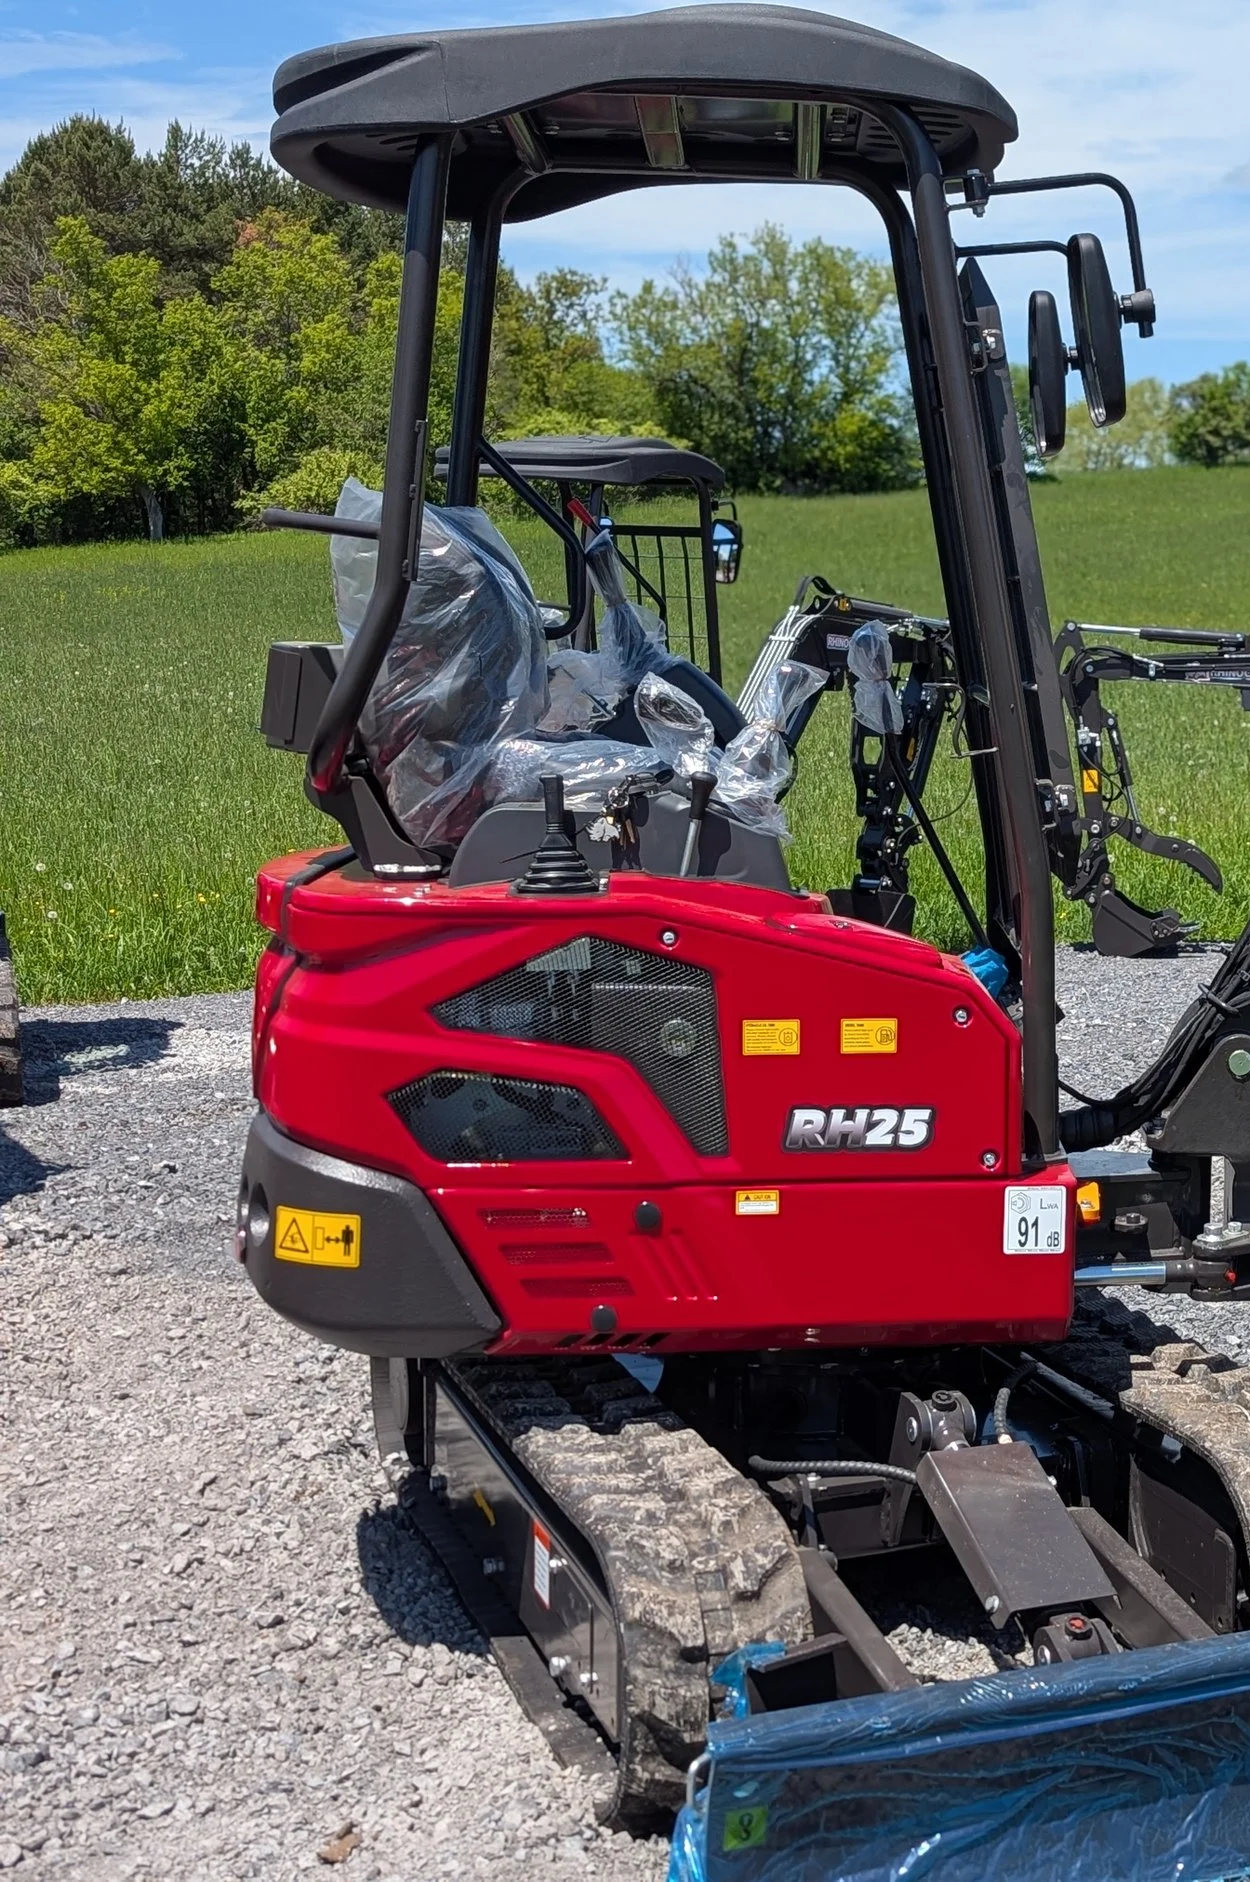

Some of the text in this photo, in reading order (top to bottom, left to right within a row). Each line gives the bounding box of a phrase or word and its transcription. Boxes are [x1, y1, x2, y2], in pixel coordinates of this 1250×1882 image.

[786, 1108, 933, 1147] RH25
[1018, 1215, 1061, 1248] 91 dB
